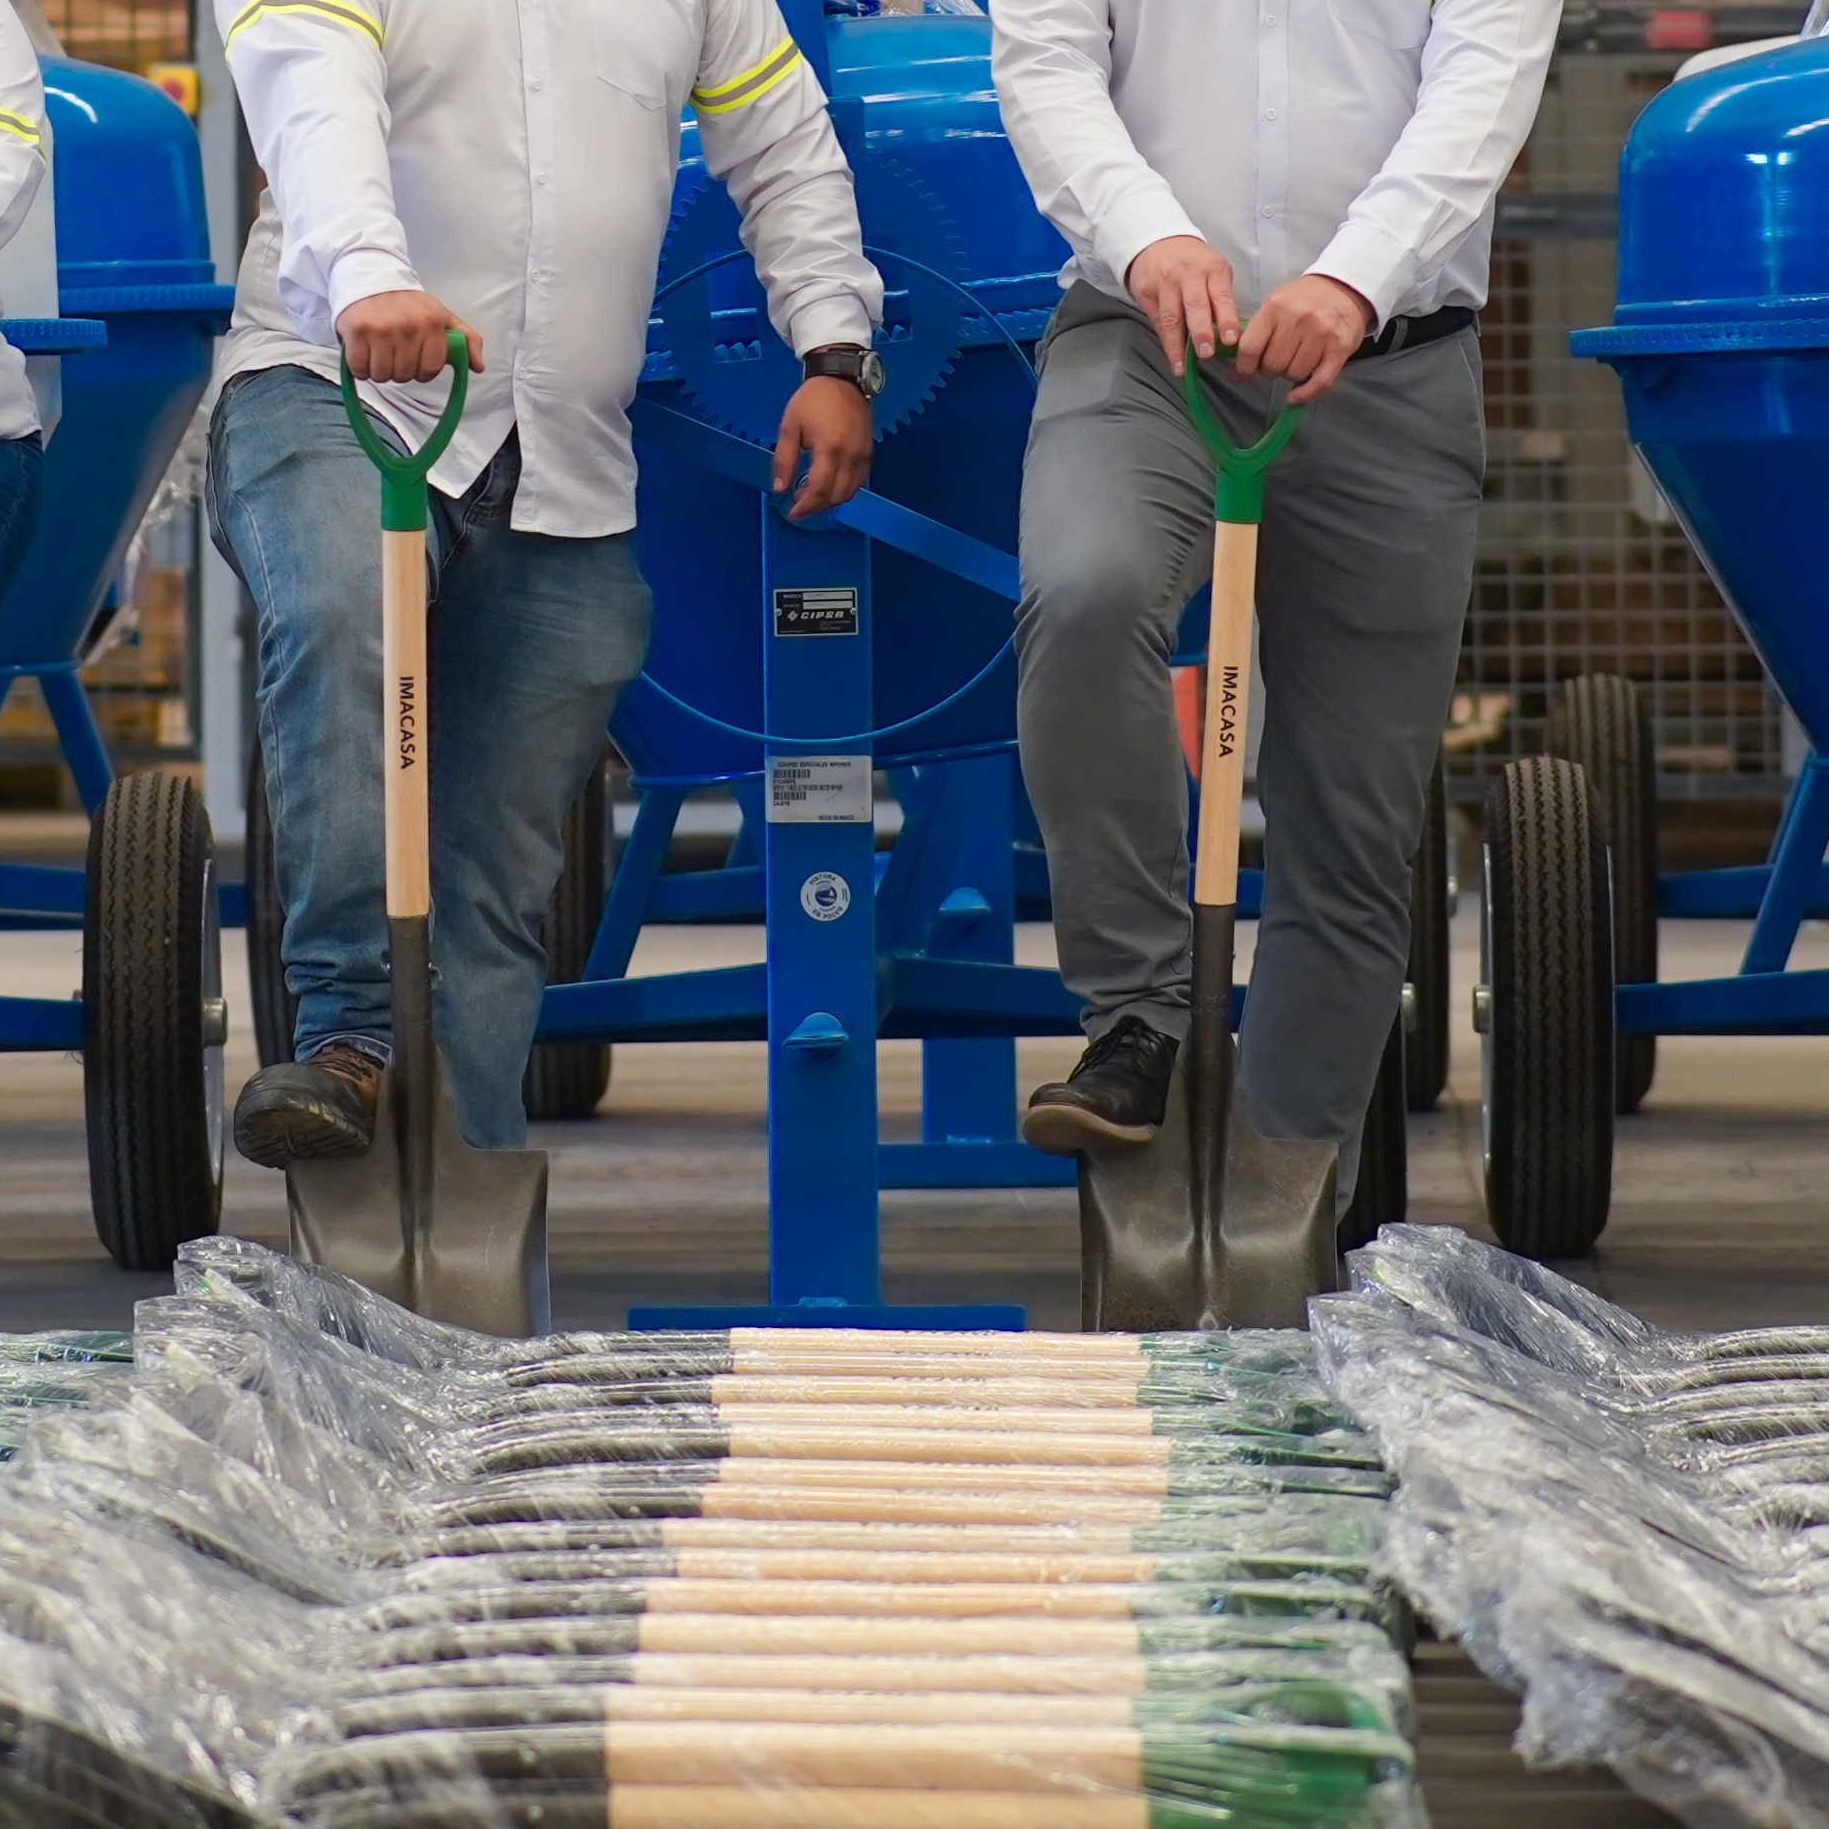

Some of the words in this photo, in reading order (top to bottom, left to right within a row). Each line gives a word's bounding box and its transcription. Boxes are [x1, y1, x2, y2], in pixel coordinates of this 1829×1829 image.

[800, 610, 845, 620] CIPSA
[398, 676, 416, 770] IMACASA
[1218, 665, 1239, 758] IMACASA
